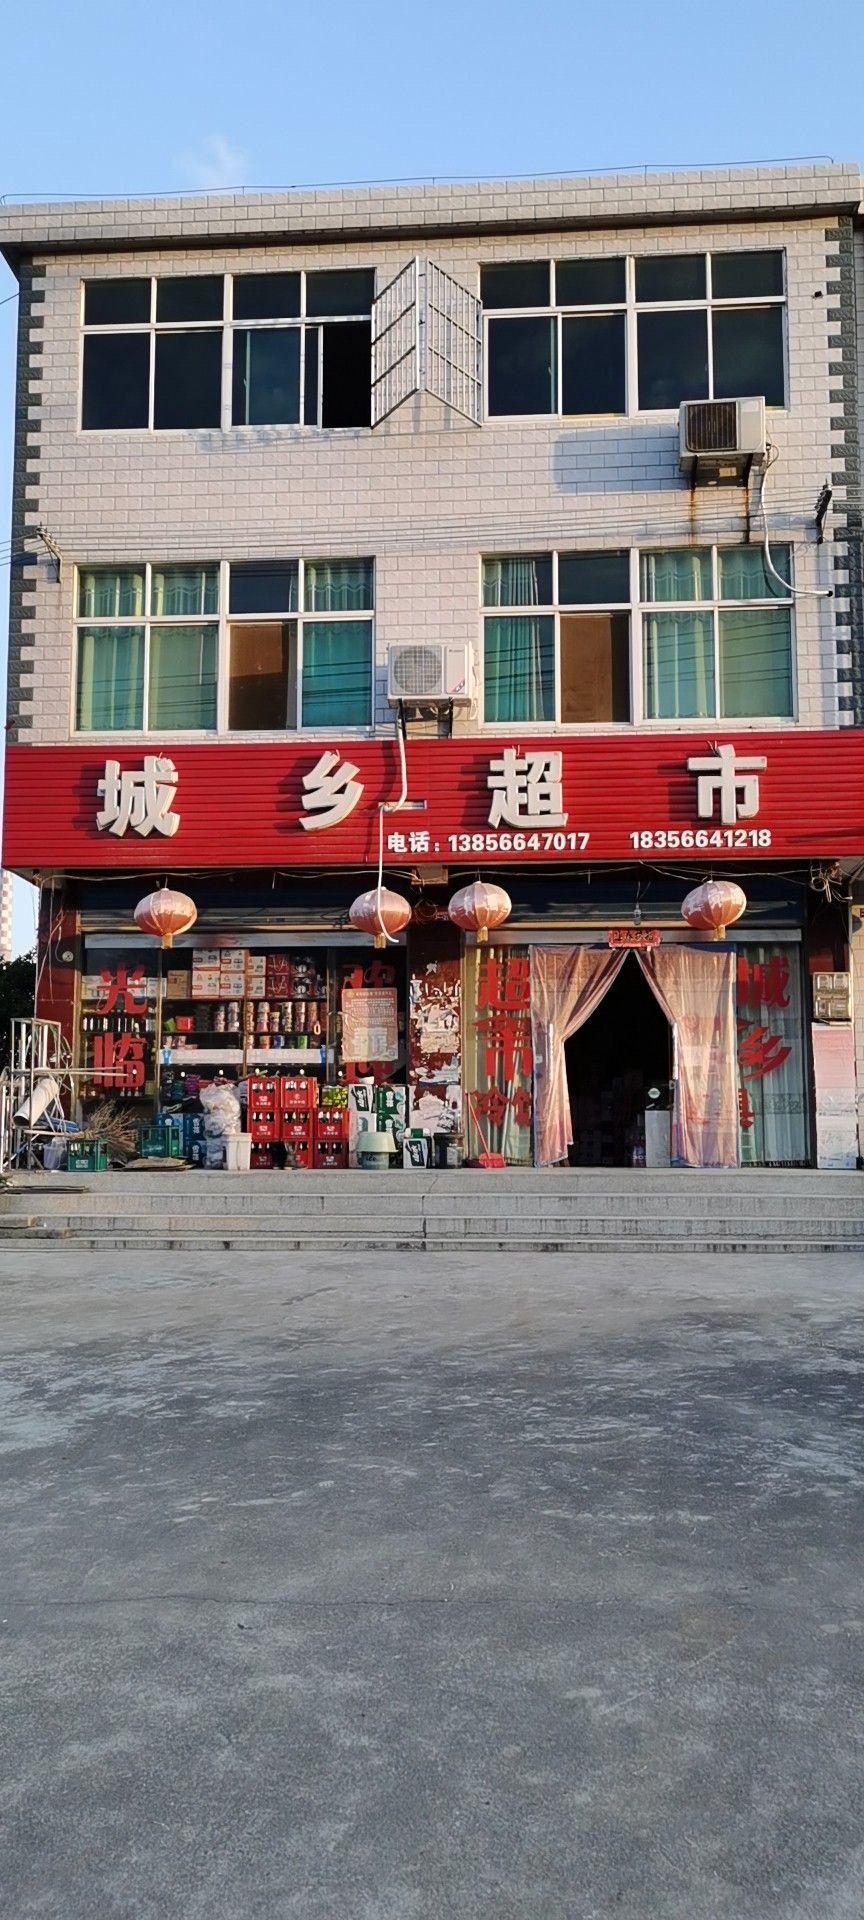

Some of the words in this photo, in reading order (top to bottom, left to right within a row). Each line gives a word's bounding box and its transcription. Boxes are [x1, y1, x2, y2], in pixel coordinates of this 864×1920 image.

[95, 747, 768, 837] 城乡超市
[629, 829, 772, 849] 18356641218
[92, 964, 148, 1088] 光临
